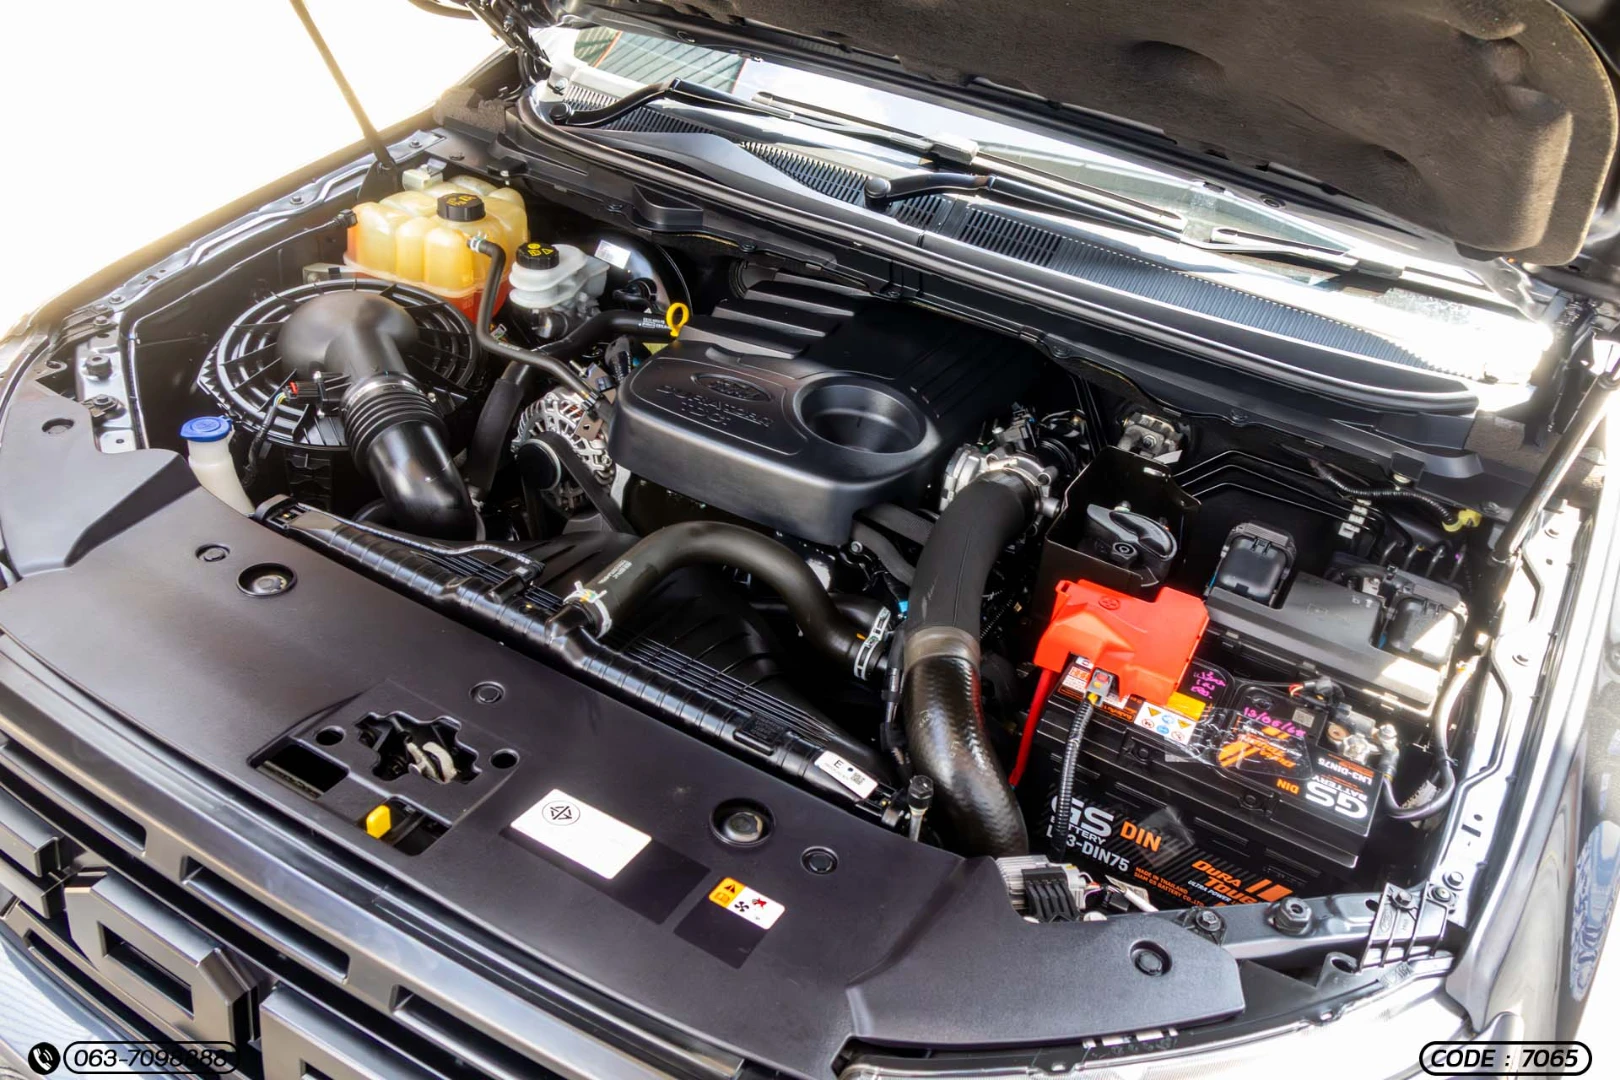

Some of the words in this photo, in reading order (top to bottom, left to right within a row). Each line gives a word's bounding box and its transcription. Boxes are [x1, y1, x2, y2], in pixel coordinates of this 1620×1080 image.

[1318, 757, 1373, 786] LN3-DIN75
[1276, 778, 1299, 795] DIN
[1305, 780, 1368, 819] GS
[1312, 774, 1368, 802] BATTERY
[1046, 824, 1130, 872] L3-DIN75
[1120, 820, 1162, 853] DIN
[1135, 867, 1152, 878] MADE
[1160, 877, 1189, 894] THAILAND
[1191, 860, 1242, 888] DURA
[1157, 882, 1182, 898] BATTERY
[1187, 879, 1208, 892] ULTRA
[1207, 889, 1232, 902] POWER
